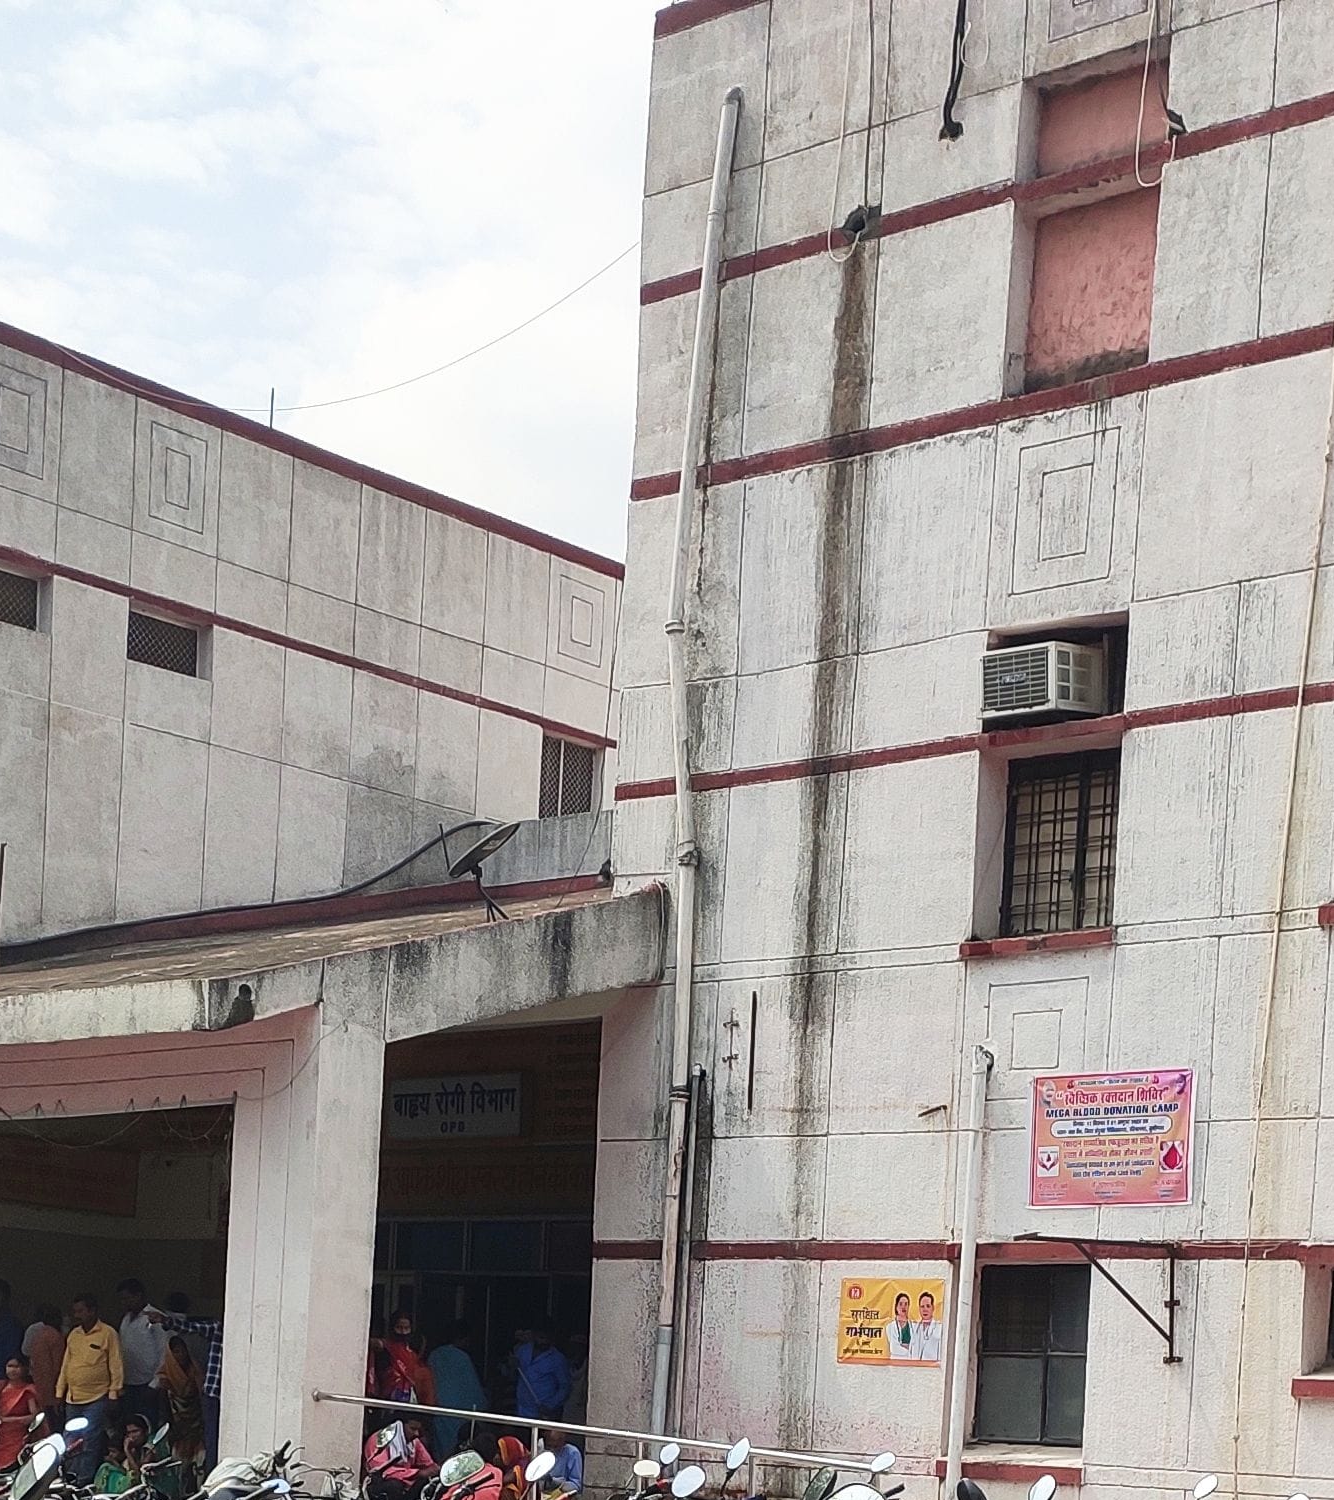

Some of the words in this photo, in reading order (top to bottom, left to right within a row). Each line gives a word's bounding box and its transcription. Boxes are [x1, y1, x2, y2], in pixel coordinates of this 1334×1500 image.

[434, 1081, 466, 1115] रोगी
[469, 1081, 517, 1114] विभाग
[1045, 1108, 1070, 1118] MEGA
[1072, 1107, 1100, 1117] BLOOD
[1103, 1104, 1149, 1115] DONATION
[1152, 1102, 1179, 1114] CAMP
[846, 1324, 883, 1338] गर्भपात
